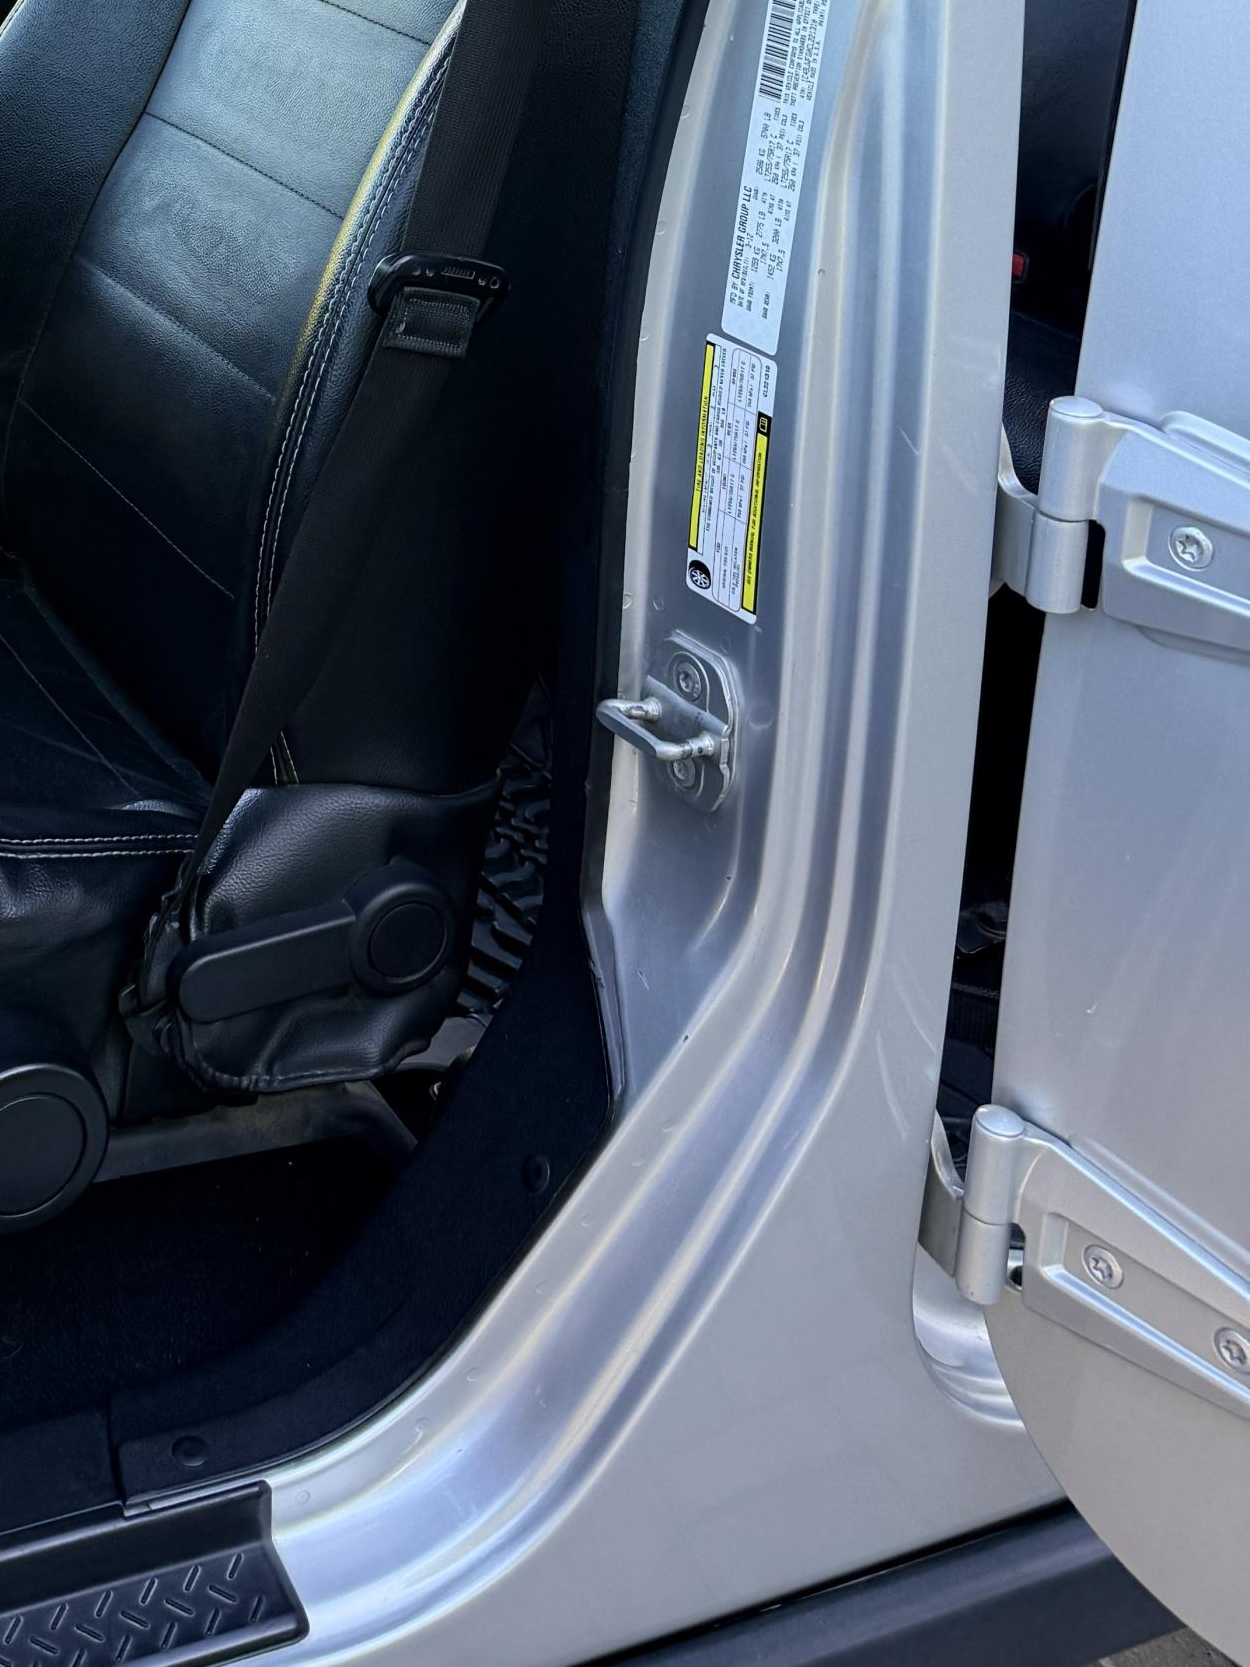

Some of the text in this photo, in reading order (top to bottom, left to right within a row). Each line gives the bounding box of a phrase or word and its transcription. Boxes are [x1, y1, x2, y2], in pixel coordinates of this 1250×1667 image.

[757, 147, 765, 157] KG
[763, 111, 771, 121] LB
[742, 184, 752, 203] LLC
[759, 241, 769, 265] 17X7.5
[776, 141, 784, 151] 37
[775, 247, 785, 272] 17X7.5
[792, 147, 800, 157] 37
[737, 202, 750, 234] GROUP
[755, 220, 764, 238] 2775
[757, 210, 766, 220] LB
[731, 234, 745, 280] CHRYSLER
[752, 245, 760, 256] KG
[768, 252, 776, 263] KG
[774, 216, 782, 227] LB
[731, 281, 738, 290] BY
[700, 394, 708, 436] INFORMATION
